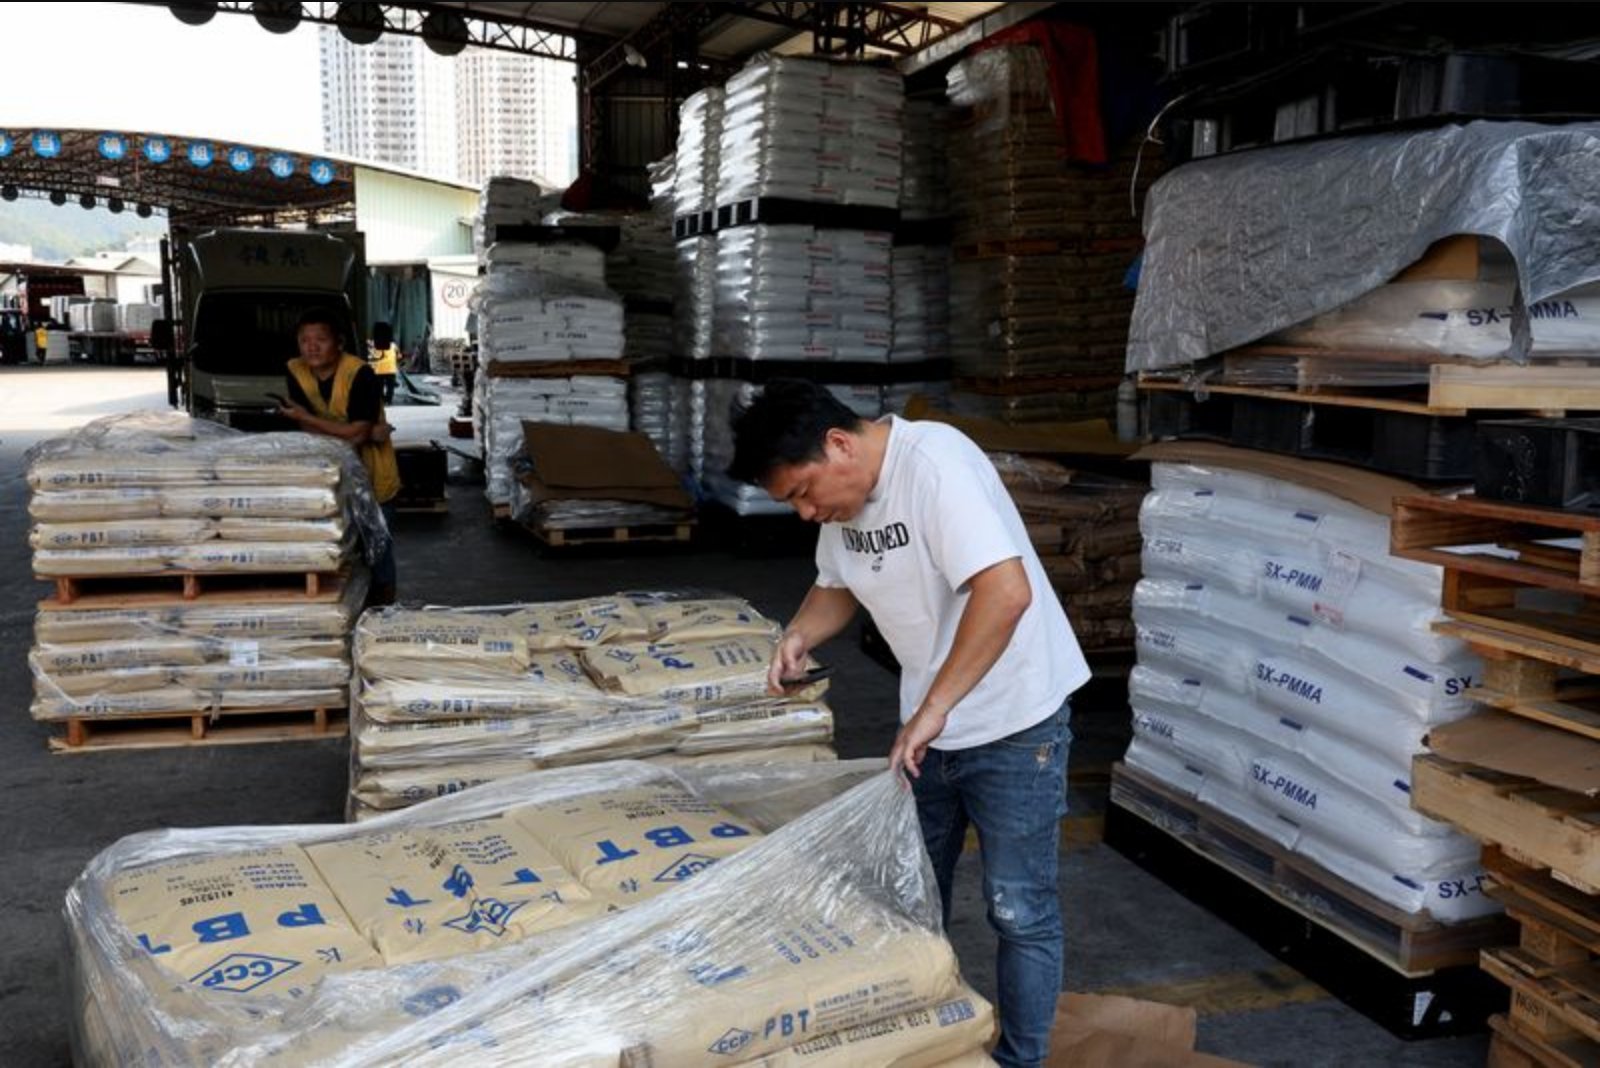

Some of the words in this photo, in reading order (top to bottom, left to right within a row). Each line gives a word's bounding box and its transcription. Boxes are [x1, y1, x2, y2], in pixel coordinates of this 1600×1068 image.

[447, 285, 465, 298] 20
[1467, 301, 1578, 326] SX-MMA
[694, 685, 721, 701] PBT
[1256, 663, 1323, 704] SX-PMMA
[443, 698, 474, 712] PBT
[1252, 765, 1318, 810] SX-PMMA
[596, 822, 750, 866] PBT
[202, 960, 274, 988] CCP
[763, 1009, 809, 1039] PBT
